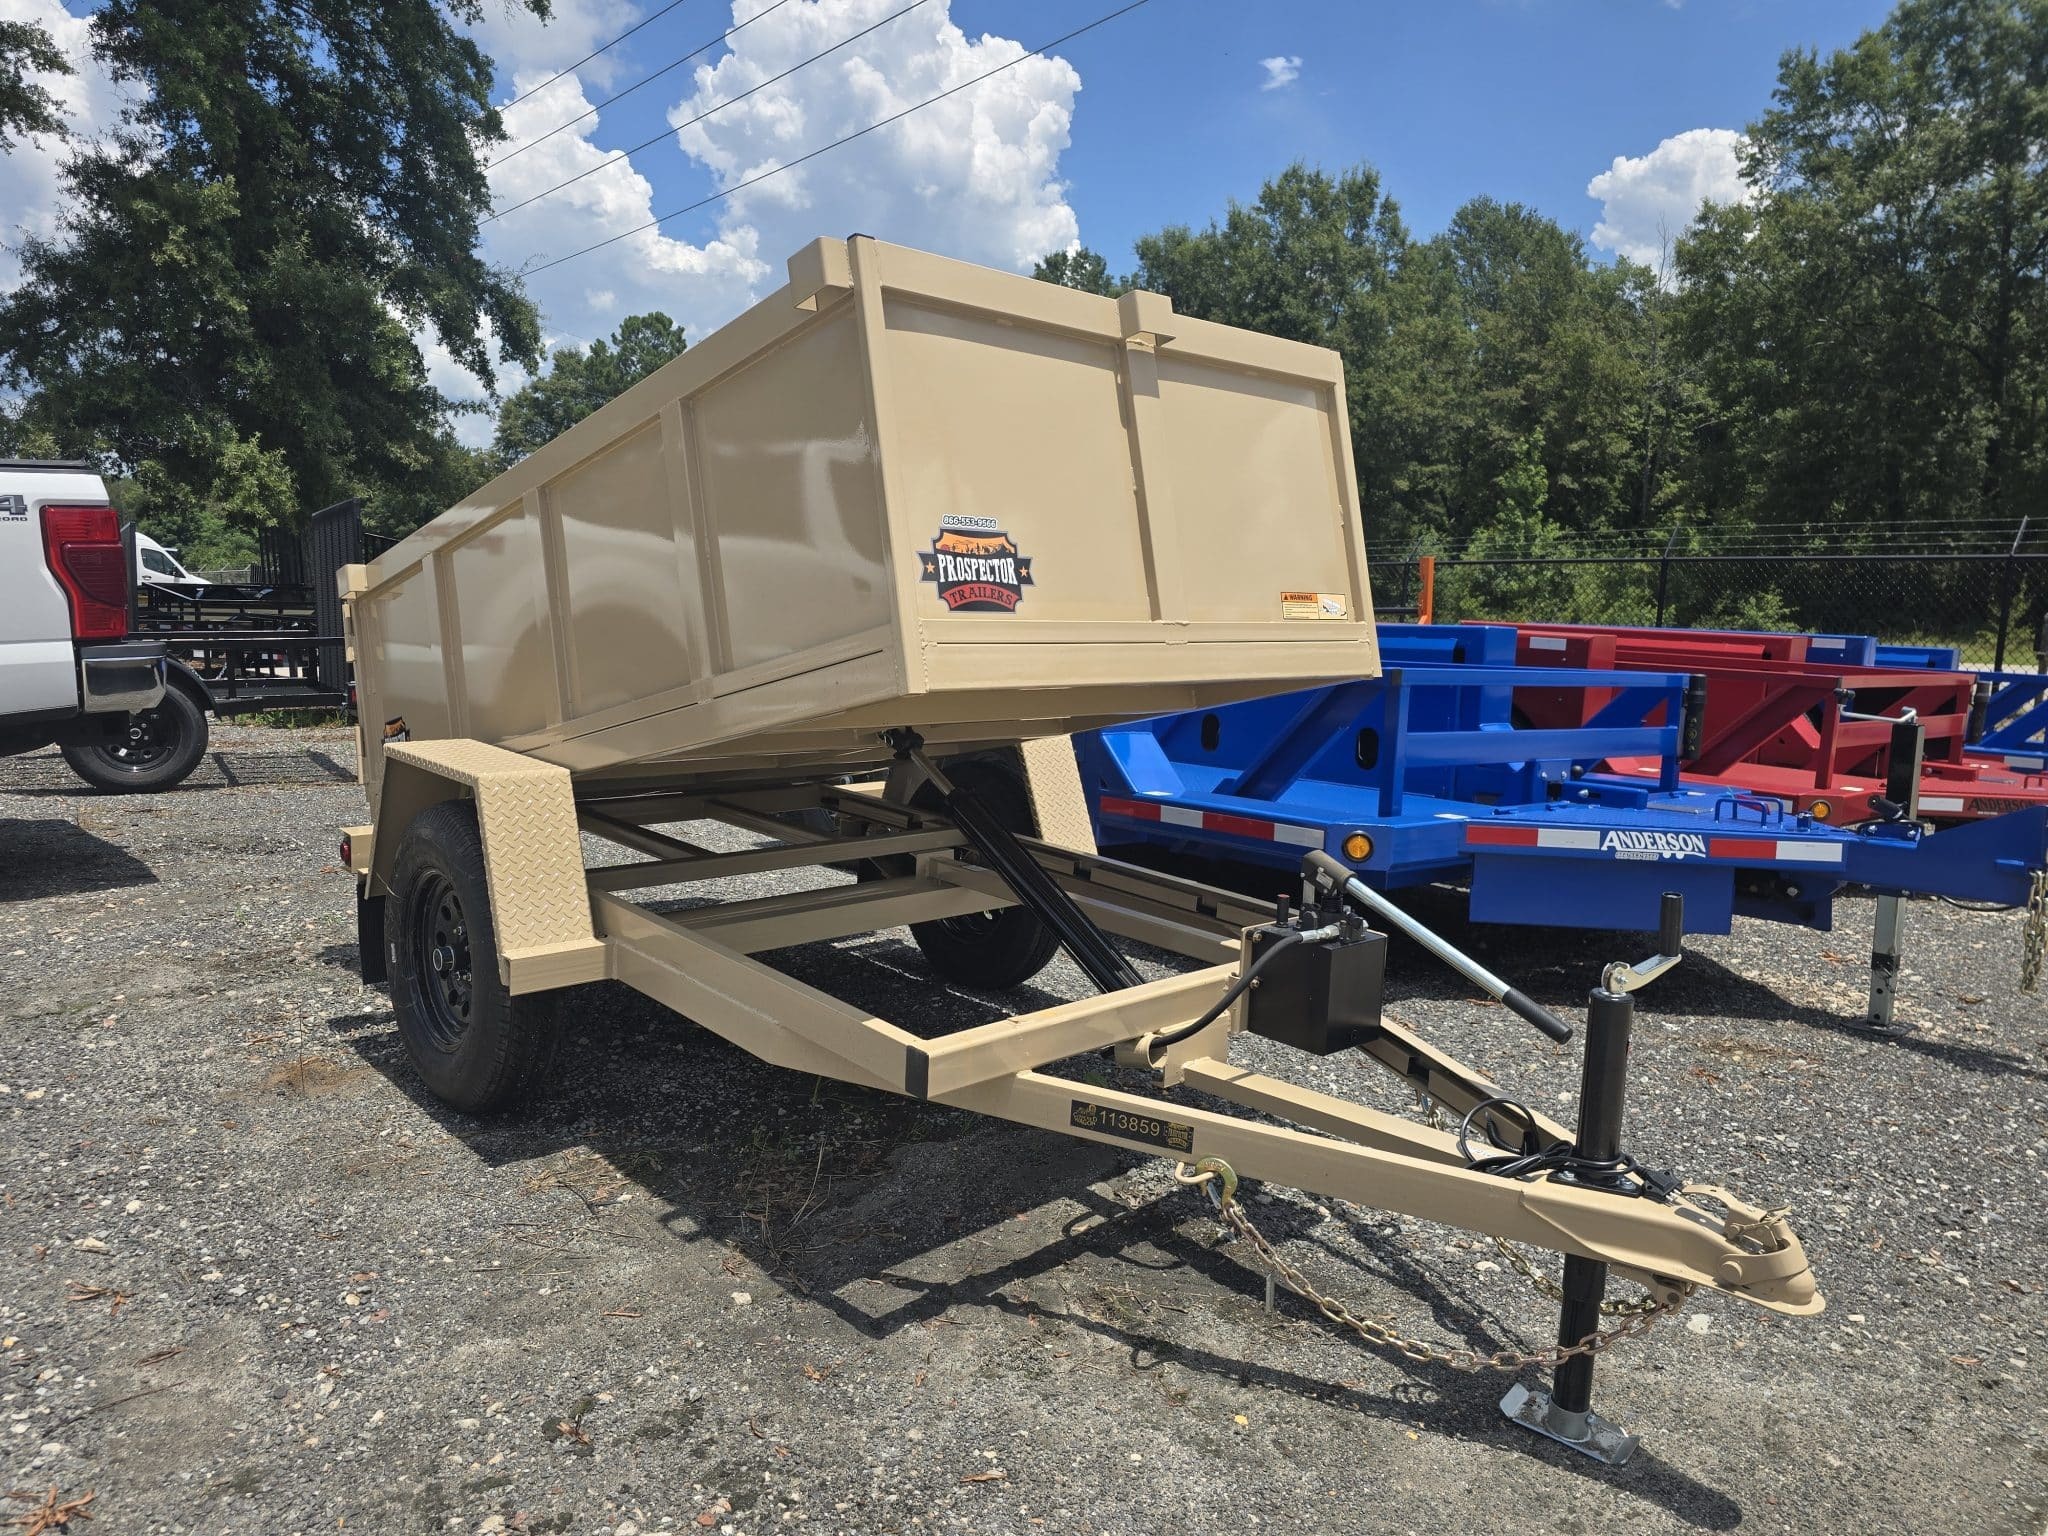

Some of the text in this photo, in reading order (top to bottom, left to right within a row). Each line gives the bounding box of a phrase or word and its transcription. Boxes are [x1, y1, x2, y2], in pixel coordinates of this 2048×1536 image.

[943, 516, 997, 528] 866-553-9566
[937, 553, 1018, 585] PROSPECTOR
[949, 587, 1013, 605] TRAILERS
[1601, 831, 1706, 852] ANDERSON
[1100, 1111, 1160, 1136] 113859
